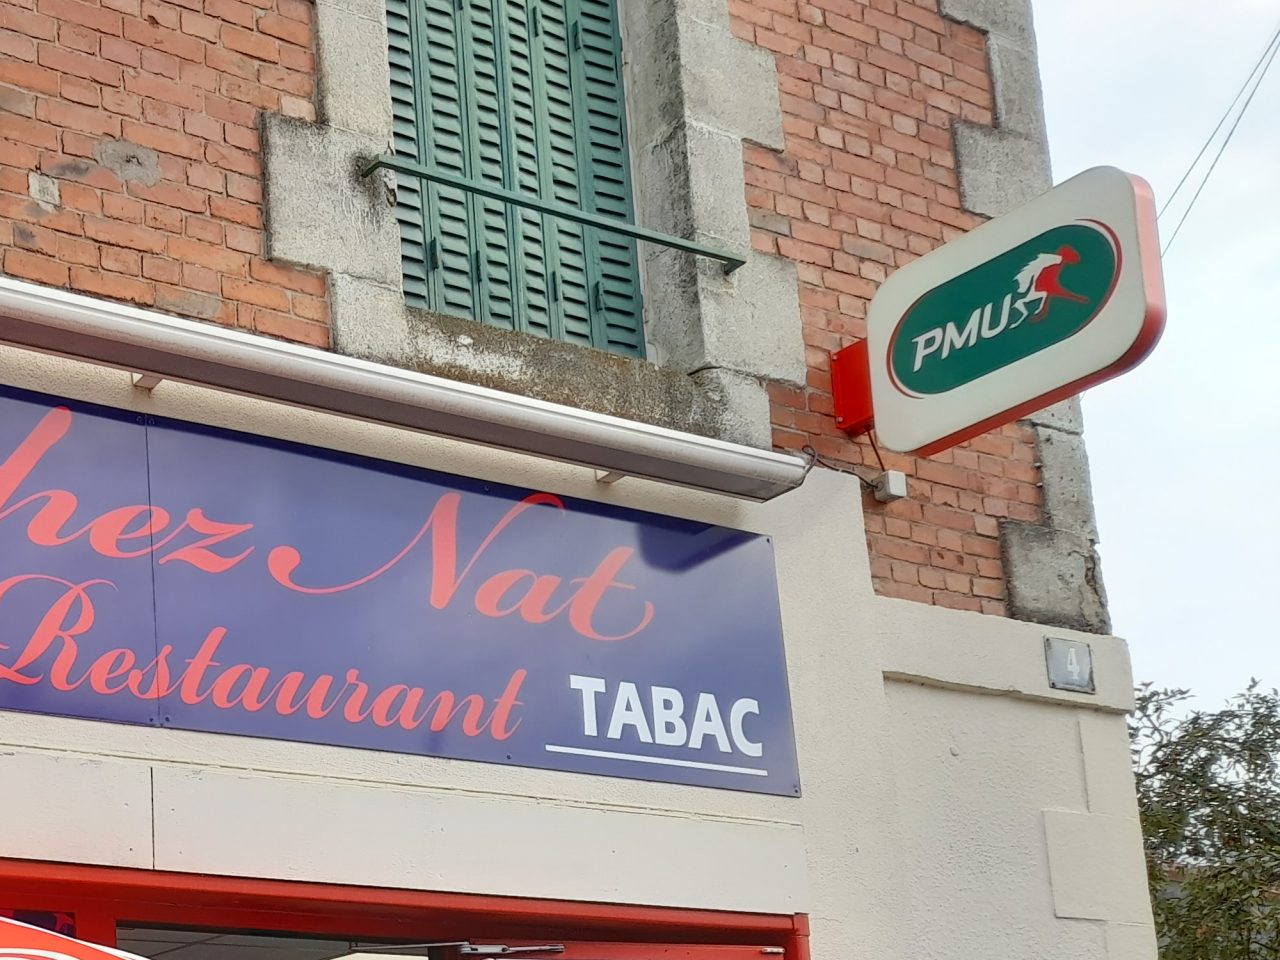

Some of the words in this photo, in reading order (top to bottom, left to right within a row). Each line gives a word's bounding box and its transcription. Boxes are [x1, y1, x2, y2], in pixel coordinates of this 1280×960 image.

[912, 293, 1013, 373] PMU
[267, 491, 654, 641] Nat
[1067, 648, 1079, 680] 4
[570, 675, 764, 757] TABAC
